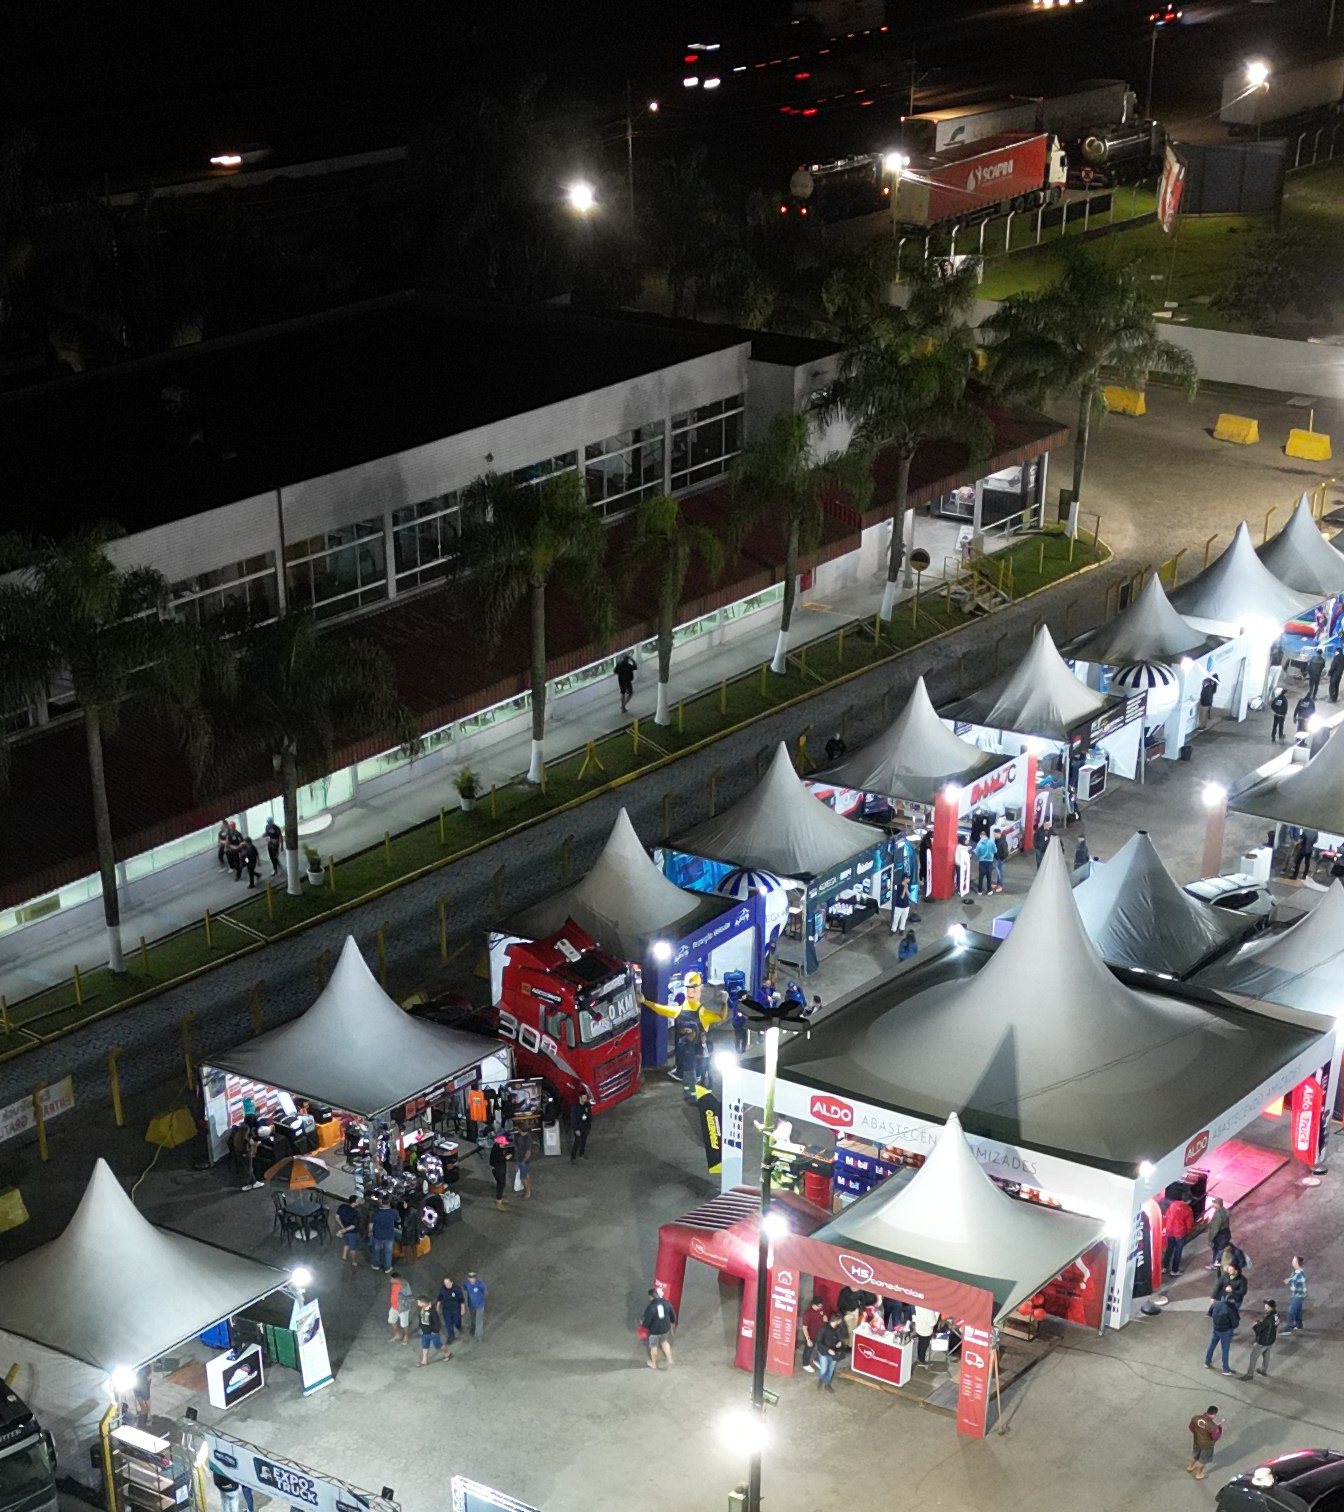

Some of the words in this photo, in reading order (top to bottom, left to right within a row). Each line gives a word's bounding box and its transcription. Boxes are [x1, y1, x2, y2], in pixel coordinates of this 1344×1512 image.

[618, 994, 633, 1015] KM
[1303, 1084, 1314, 1111] Aldo
[814, 1102, 852, 1121] ALDO
[861, 1116, 938, 1146] ABASTECEN
[1299, 1116, 1310, 1146] Truck
[1186, 1135, 1208, 1160] ALDO
[851, 1265, 870, 1279] HS
[272, 1466, 309, 1490] EXPO
[276, 1479, 318, 1506] TRUCK
